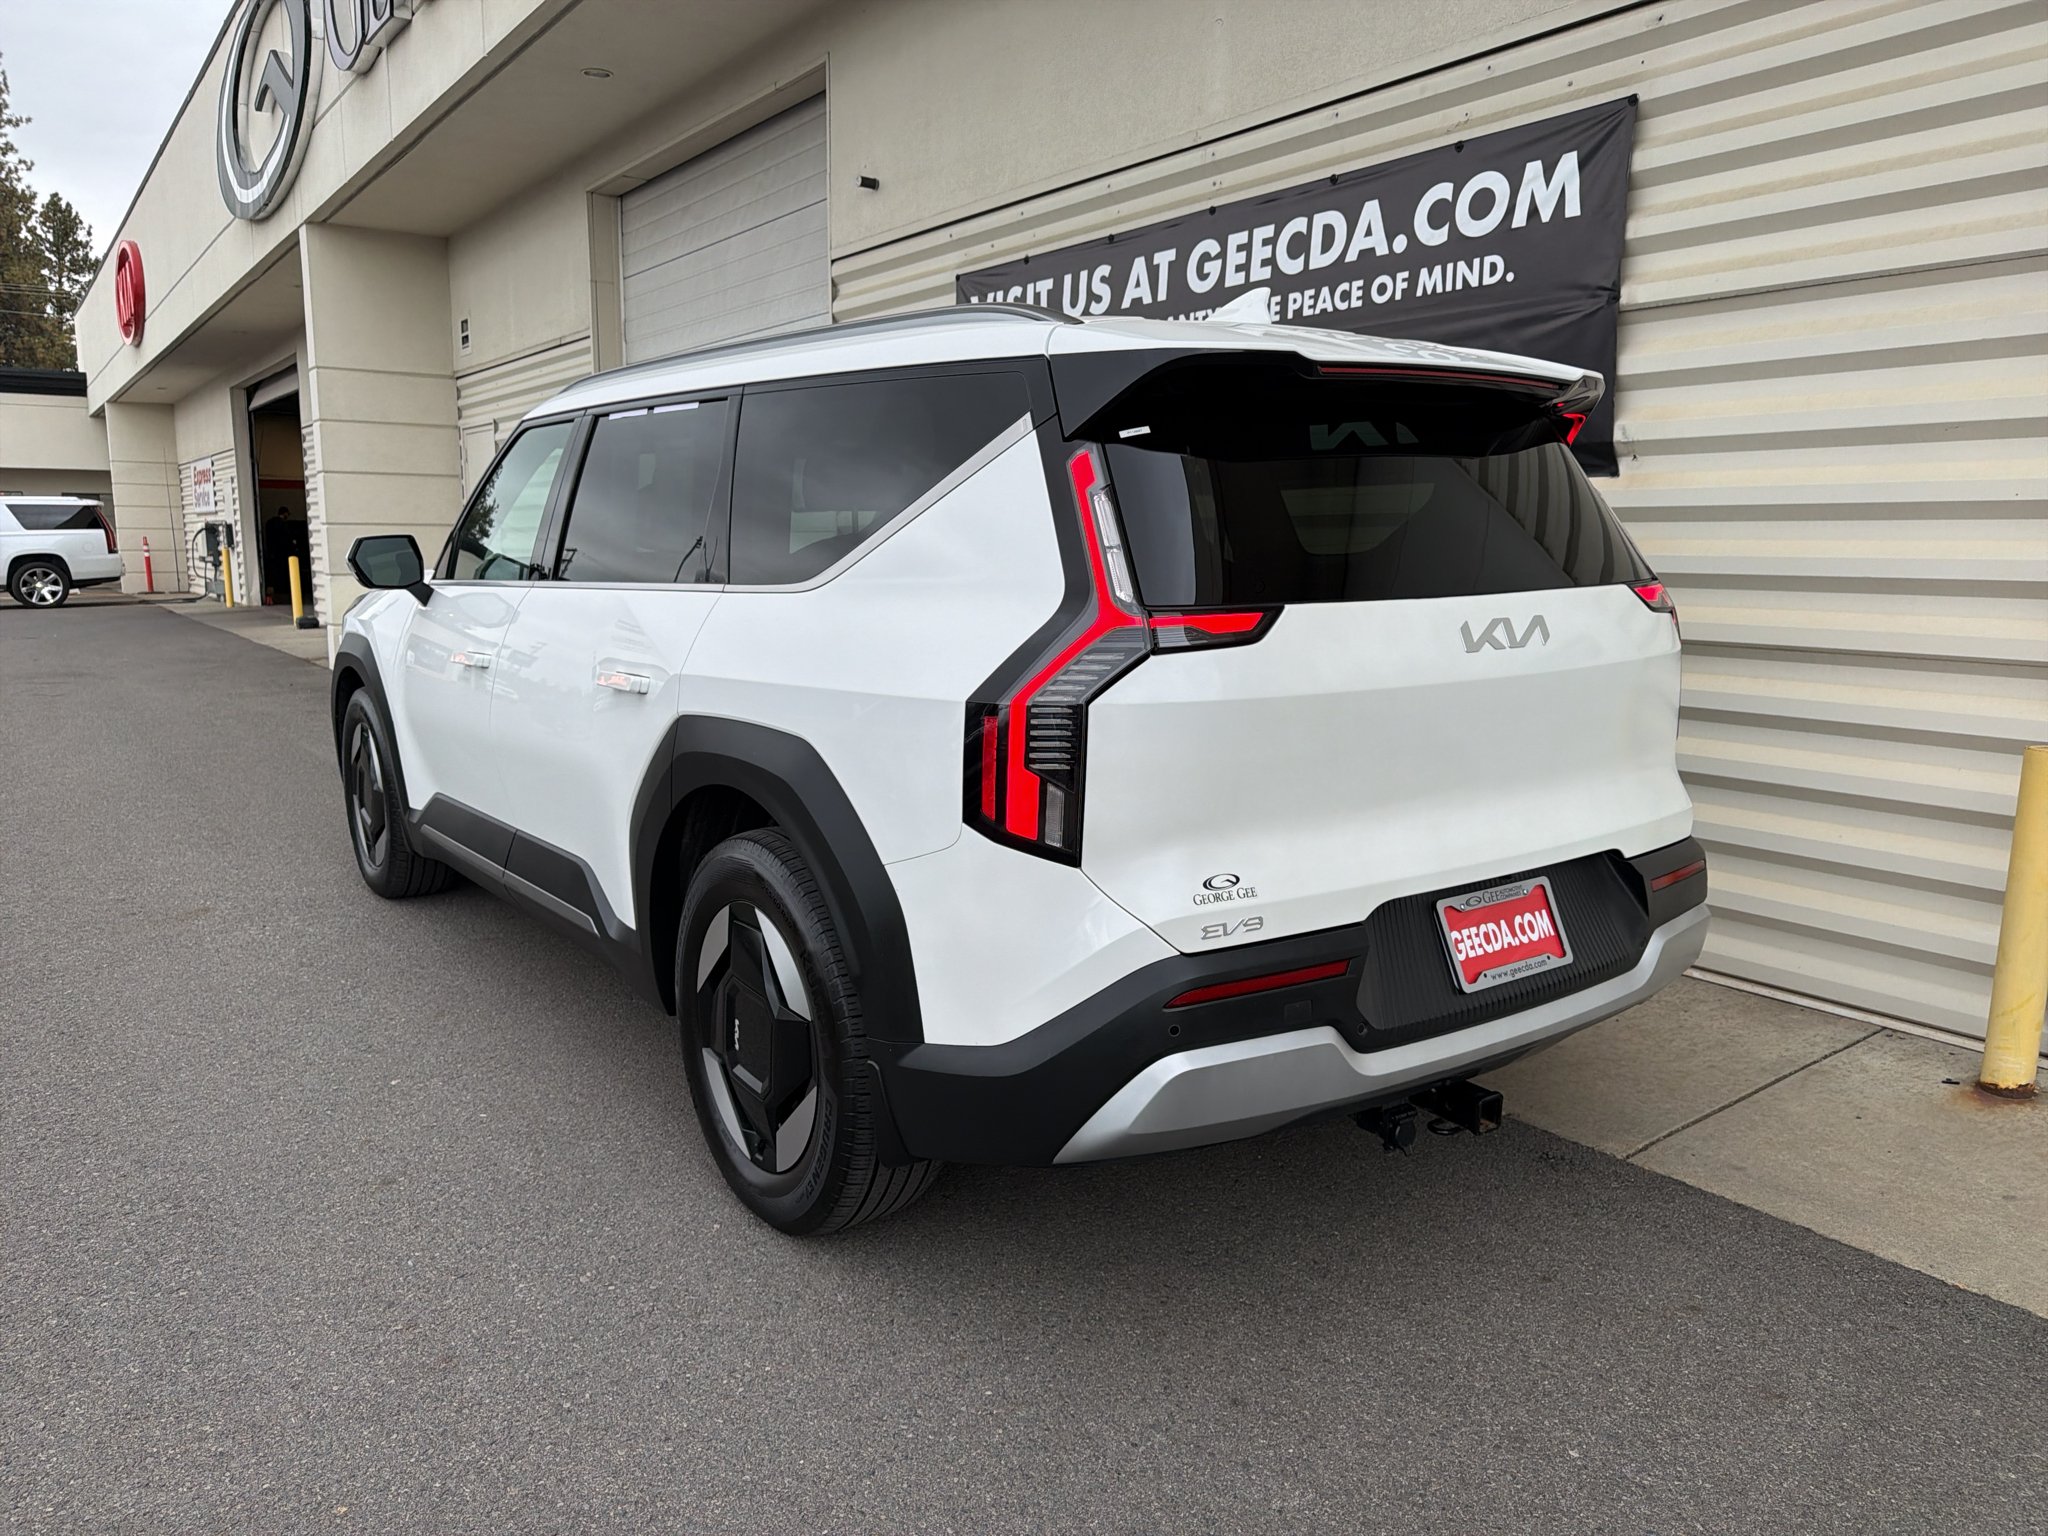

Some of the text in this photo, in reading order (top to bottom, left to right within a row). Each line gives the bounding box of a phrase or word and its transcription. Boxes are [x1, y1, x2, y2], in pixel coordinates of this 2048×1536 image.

[1062, 264, 1111, 318] US
[1121, 248, 1176, 309] AT
[1186, 151, 1581, 293] GEECDA.COM
[1287, 281, 1369, 320] PEACE
[1371, 273, 1408, 303] OF
[1416, 254, 1515, 298] MIND.
[1460, 614, 1550, 653] KIA
[1193, 886, 1258, 906] GEORGE GEE
[1201, 916, 1263, 940] EV9
[1450, 909, 1555, 961] GEECDA.COM
[1490, 959, 1548, 981] www.geecda.com
